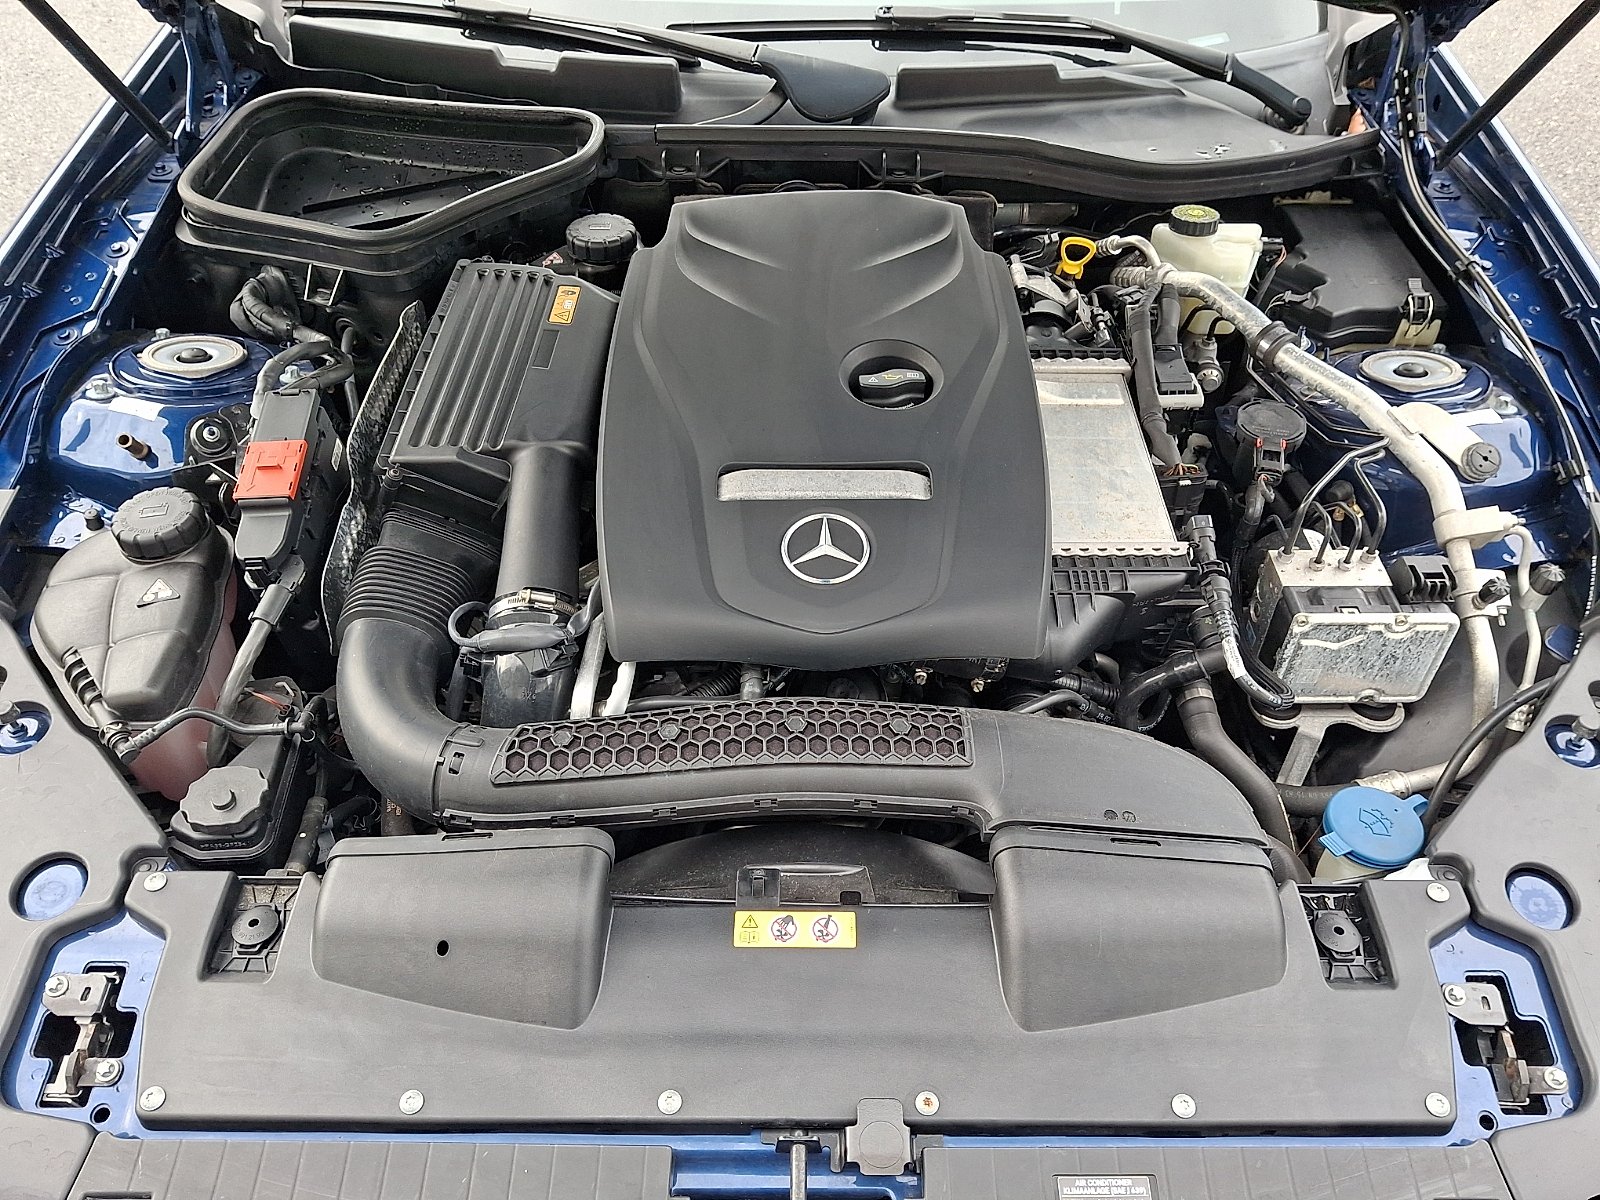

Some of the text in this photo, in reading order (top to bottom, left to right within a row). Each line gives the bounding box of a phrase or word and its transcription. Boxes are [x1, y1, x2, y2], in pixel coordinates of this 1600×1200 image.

[1075, 1179, 1132, 1187] AIR CONDITIONER
[1063, 1187, 1111, 1195] KLIMAANLAGE
